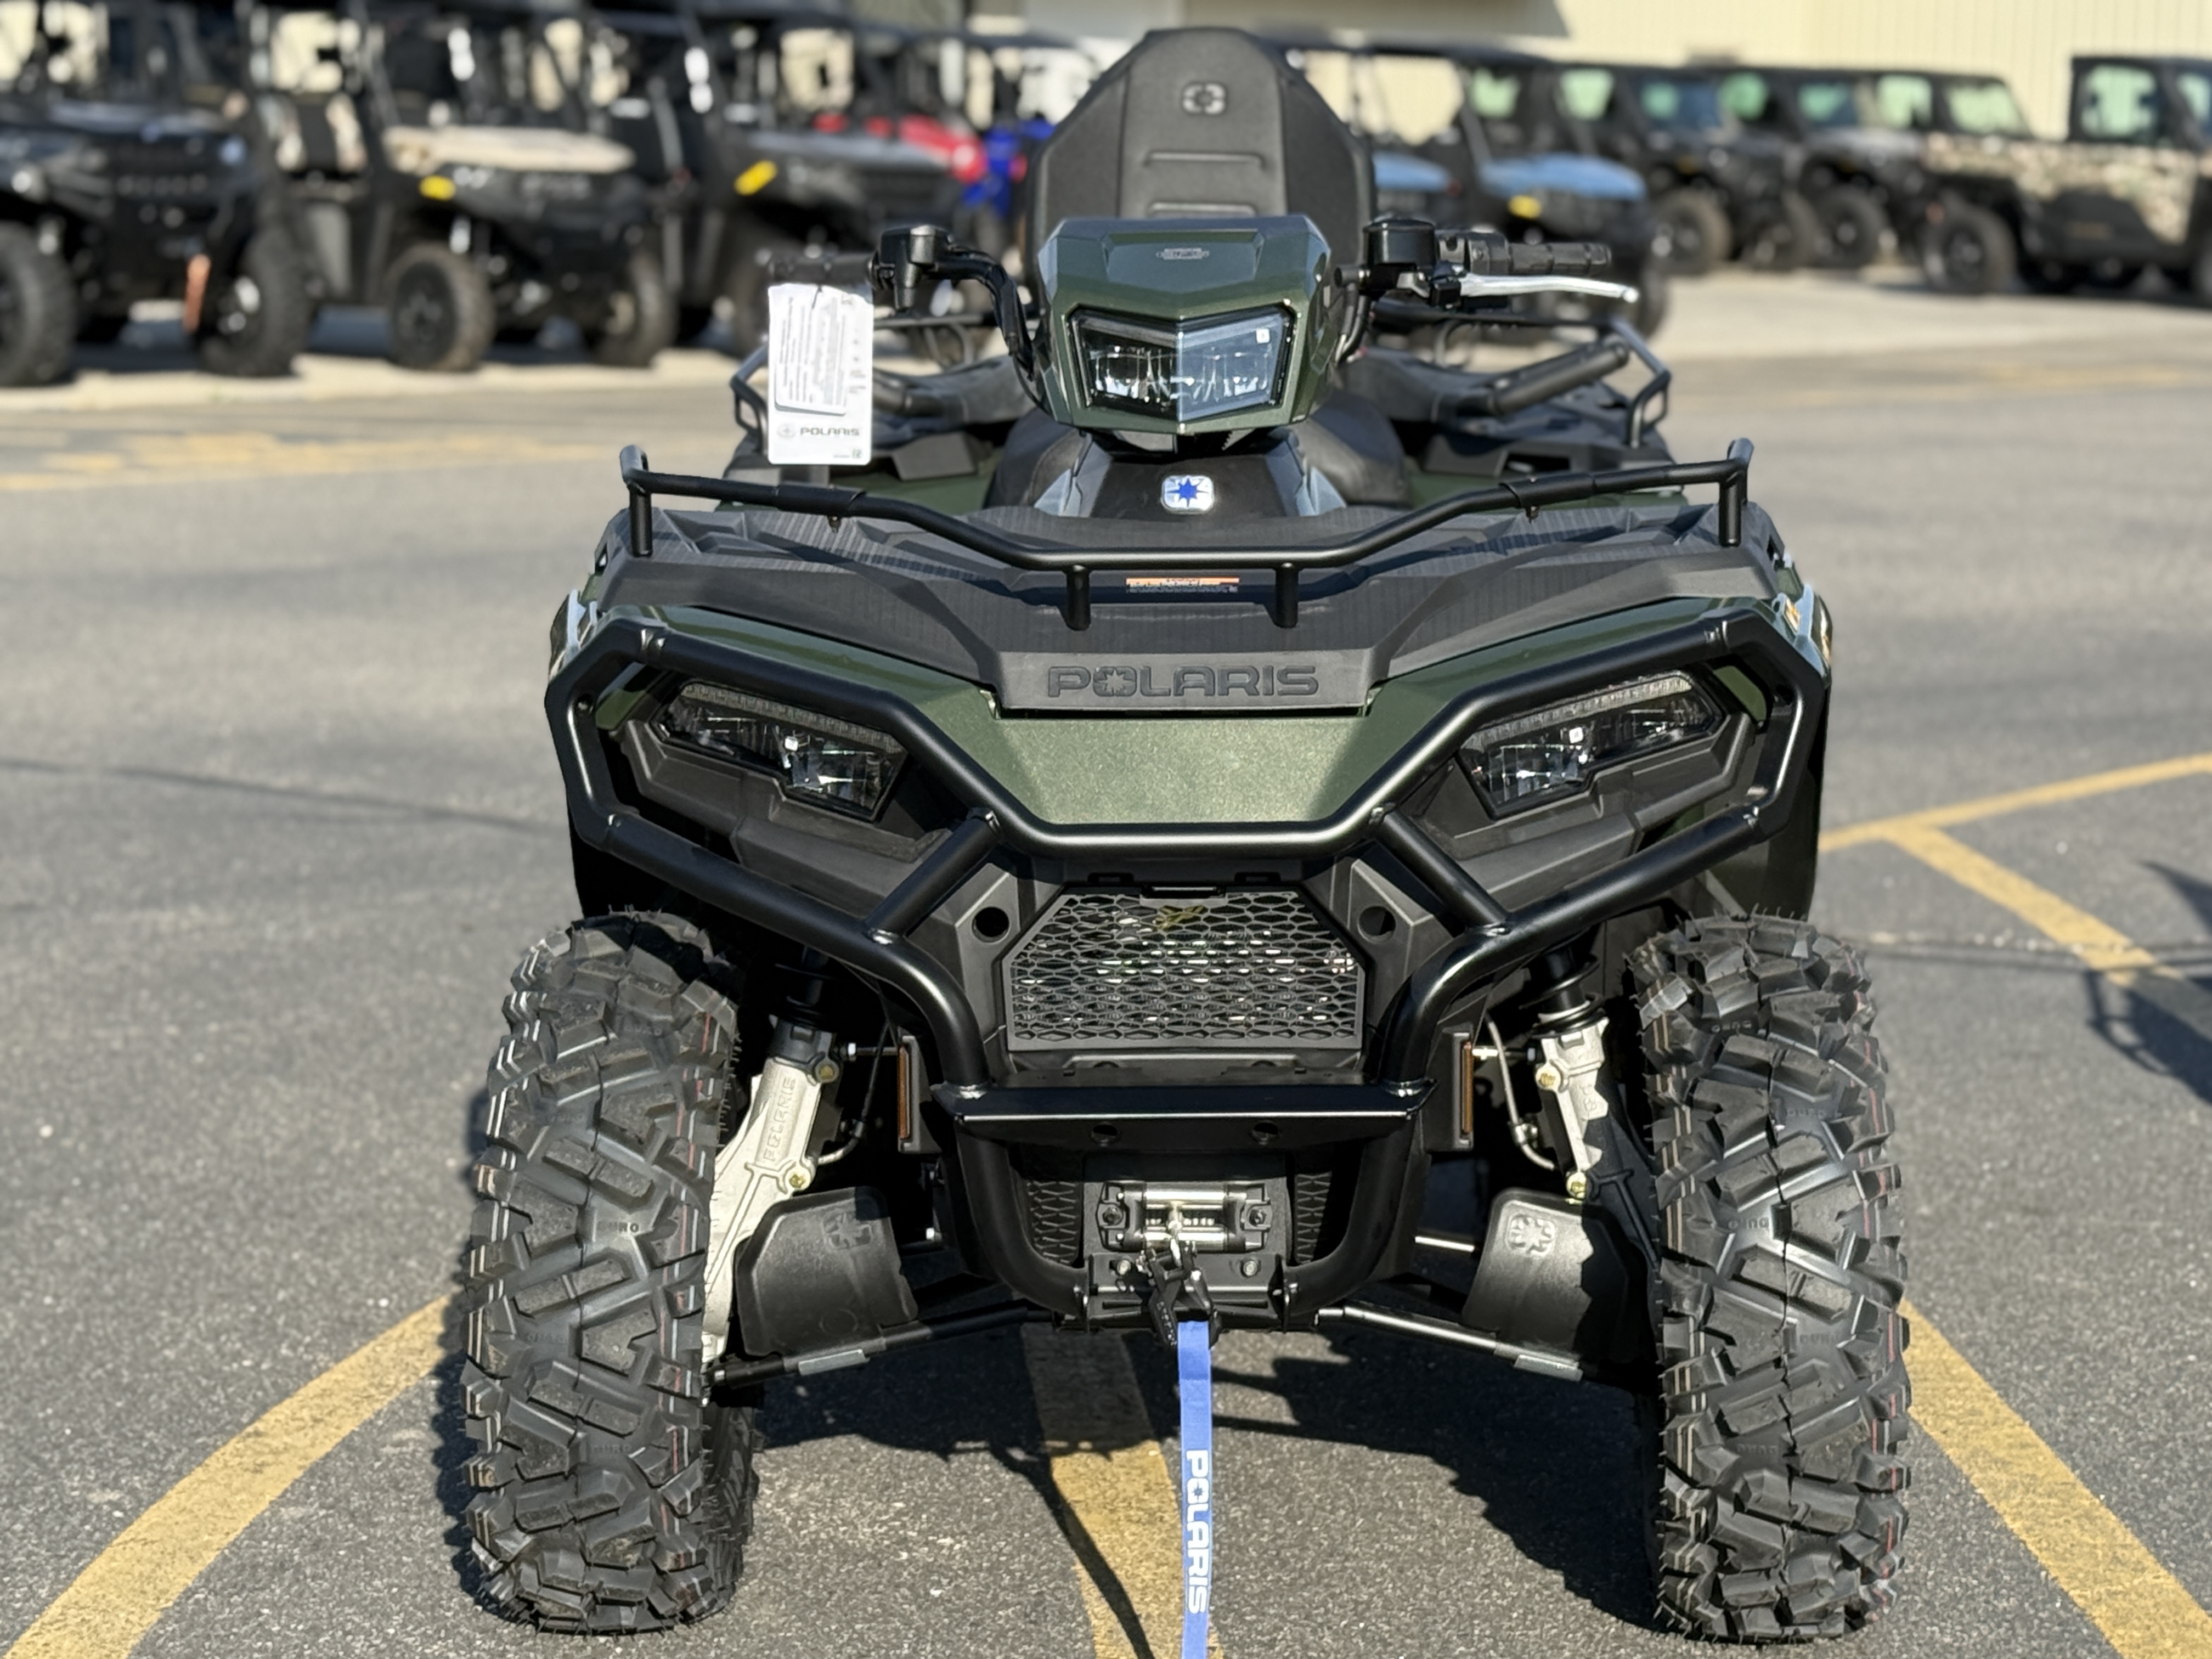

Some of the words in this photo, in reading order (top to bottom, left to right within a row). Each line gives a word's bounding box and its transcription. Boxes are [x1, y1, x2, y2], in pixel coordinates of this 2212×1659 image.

[800, 427, 860, 436] POLARIS
[1048, 665, 1319, 697] POLARIS
[763, 1076, 796, 1162] POLARIS
[1186, 1449, 1209, 1614] POLARIS
